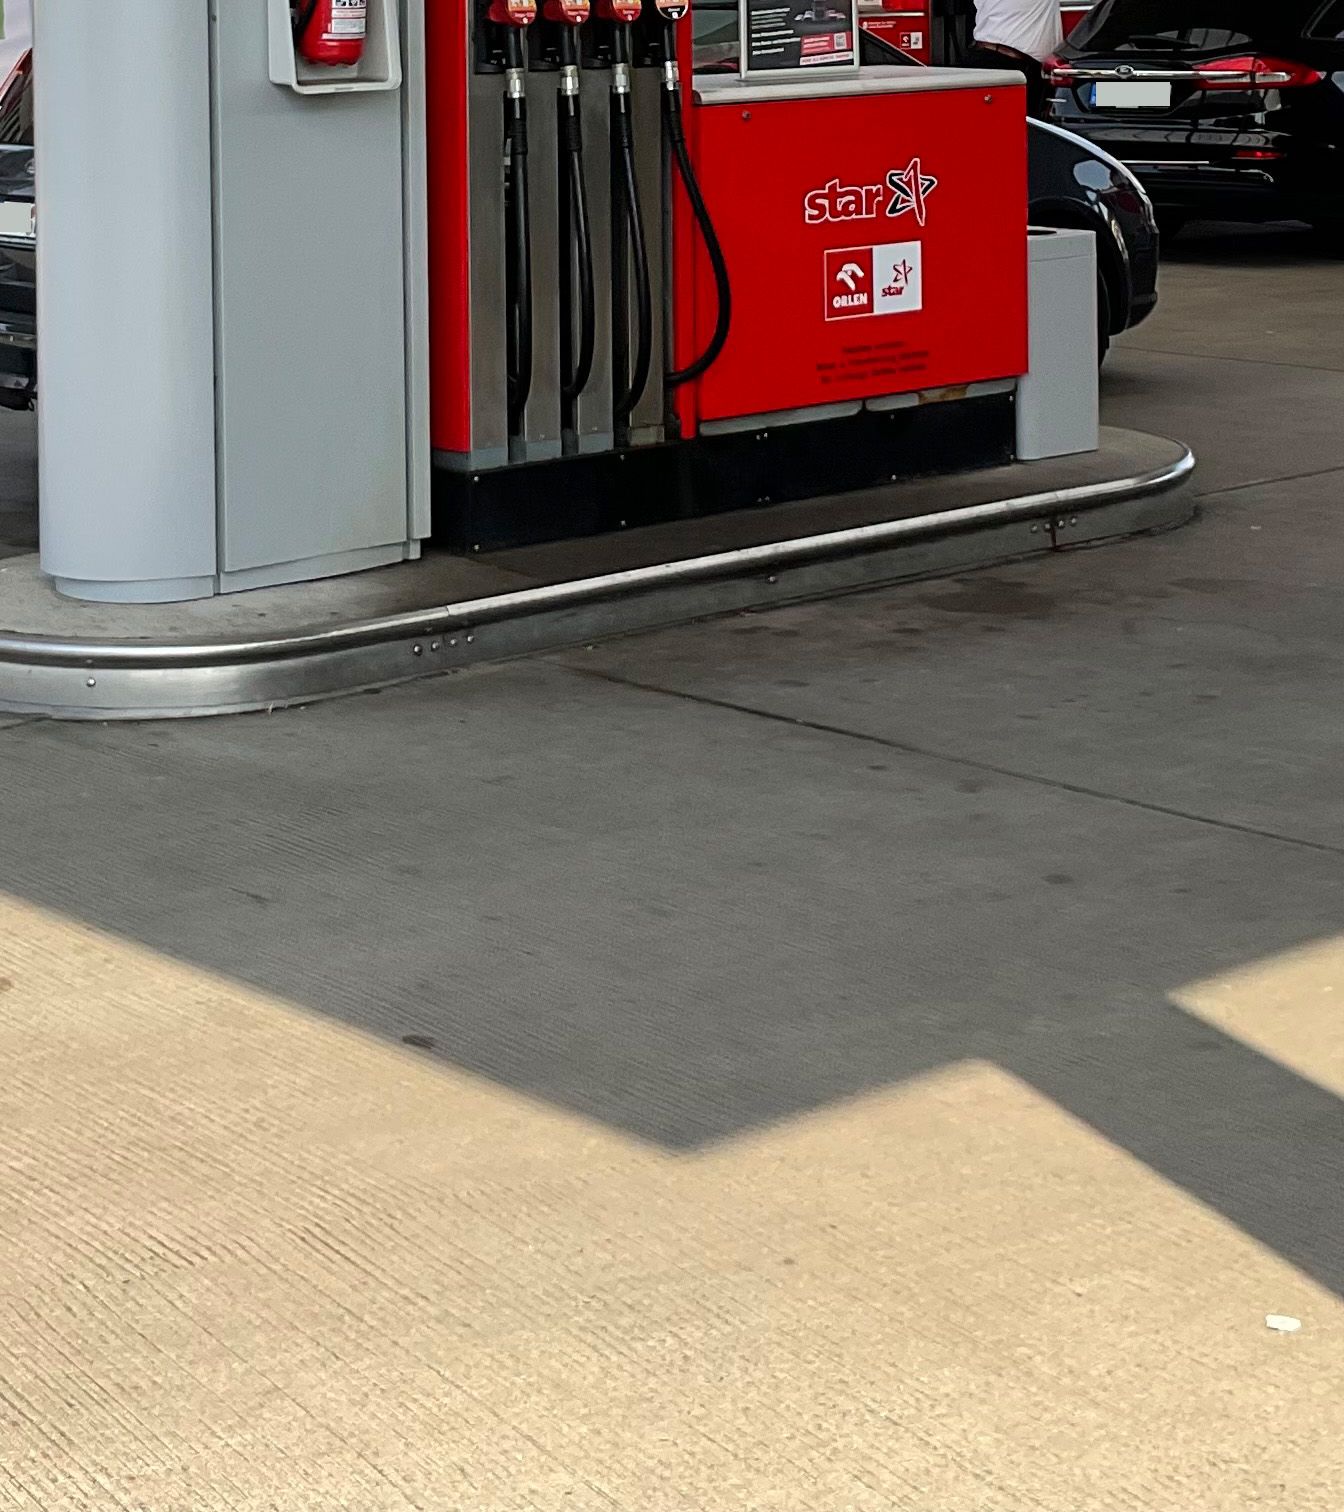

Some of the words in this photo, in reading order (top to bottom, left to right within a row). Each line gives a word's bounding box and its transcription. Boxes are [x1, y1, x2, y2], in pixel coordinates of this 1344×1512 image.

[805, 179, 883, 223] star
[881, 285, 905, 297] star
[833, 293, 868, 308] ORLEN
